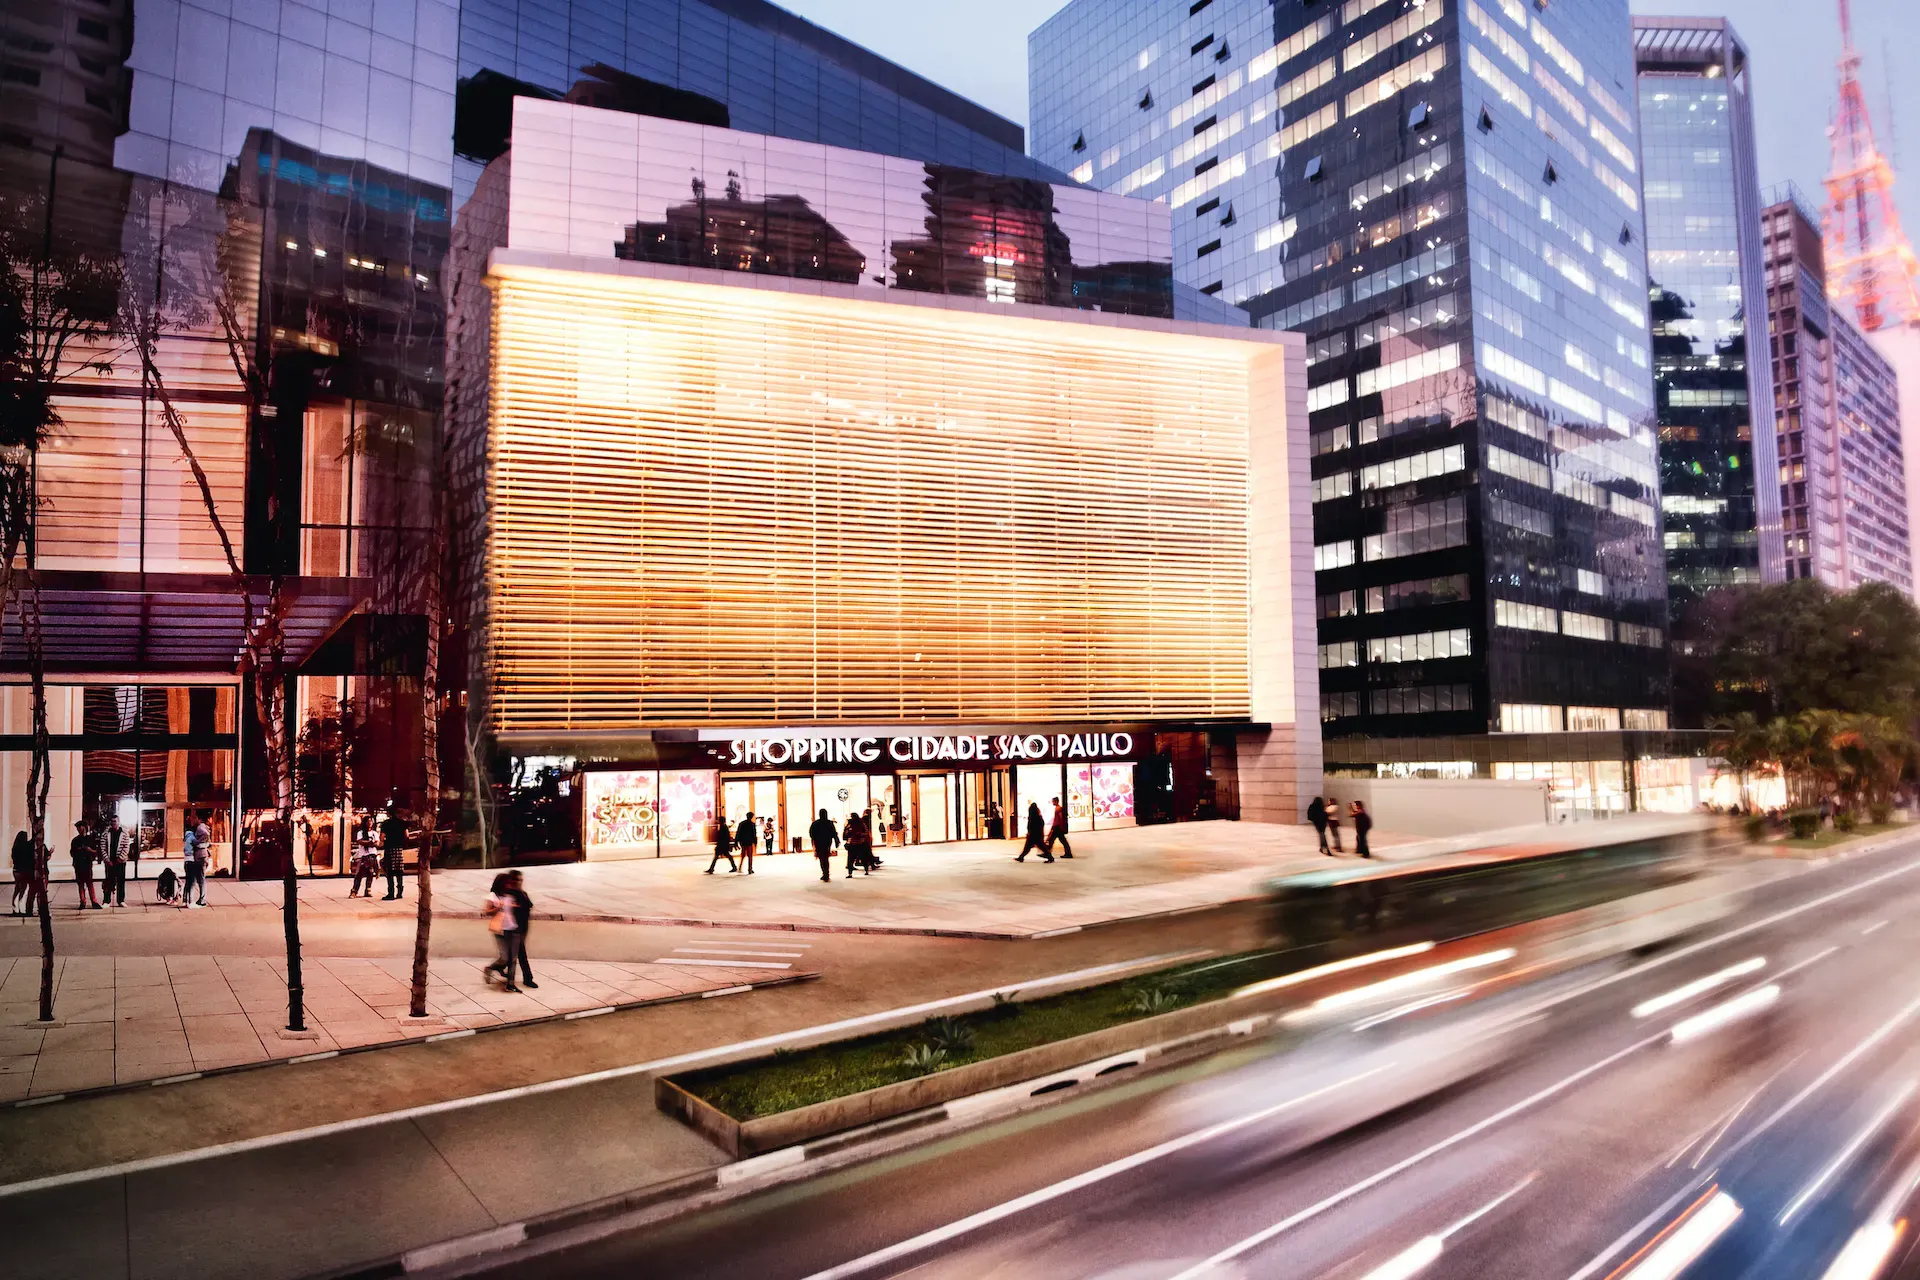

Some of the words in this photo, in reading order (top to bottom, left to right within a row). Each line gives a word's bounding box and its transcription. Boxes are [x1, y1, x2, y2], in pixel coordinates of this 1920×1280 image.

[730, 737, 881, 765] SHOPPING
[889, 736, 989, 761] CIDADE
[1057, 732, 1133, 758] PAULO
[598, 794, 654, 805] CIDAD
[596, 825, 685, 844] PAULO
